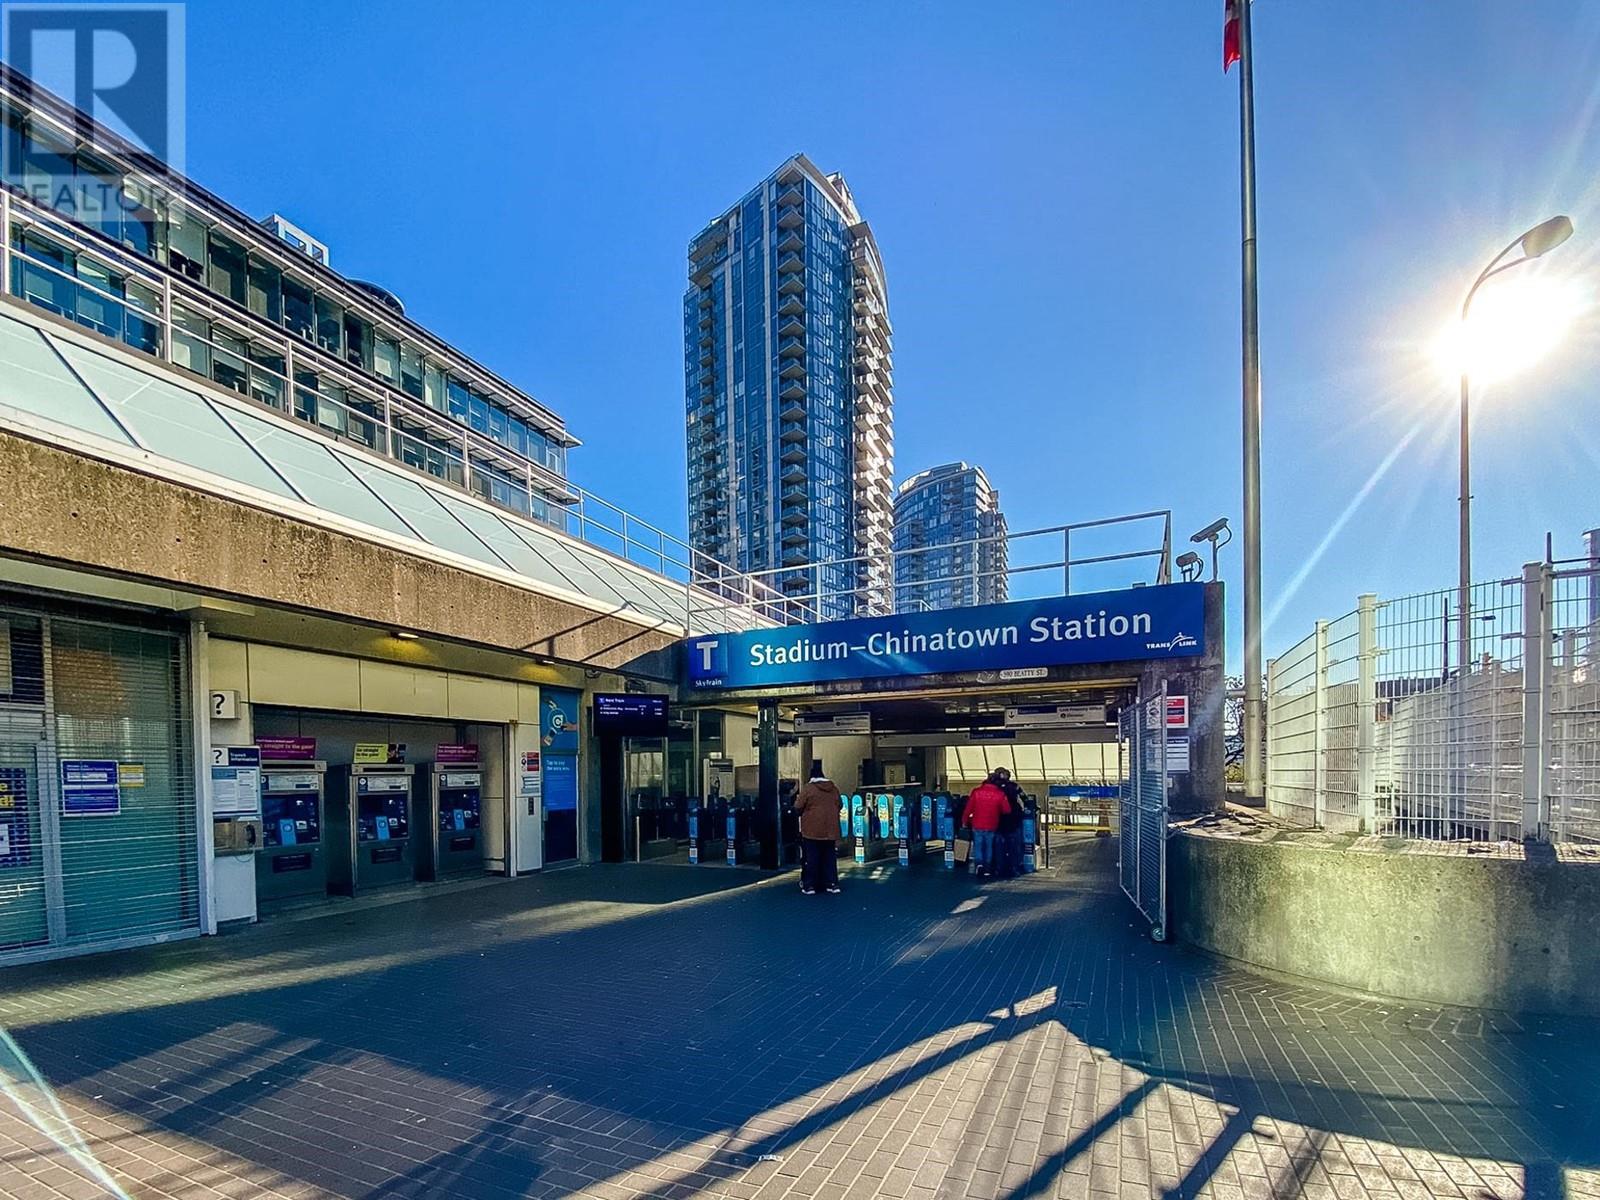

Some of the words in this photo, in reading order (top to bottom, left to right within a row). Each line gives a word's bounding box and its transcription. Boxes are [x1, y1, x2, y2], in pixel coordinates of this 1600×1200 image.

[1029, 610, 1151, 643] Station
[696, 640, 719, 670] T
[695, 678, 722, 688] SkyTrain
[1013, 669, 1035, 677] BEATTY
